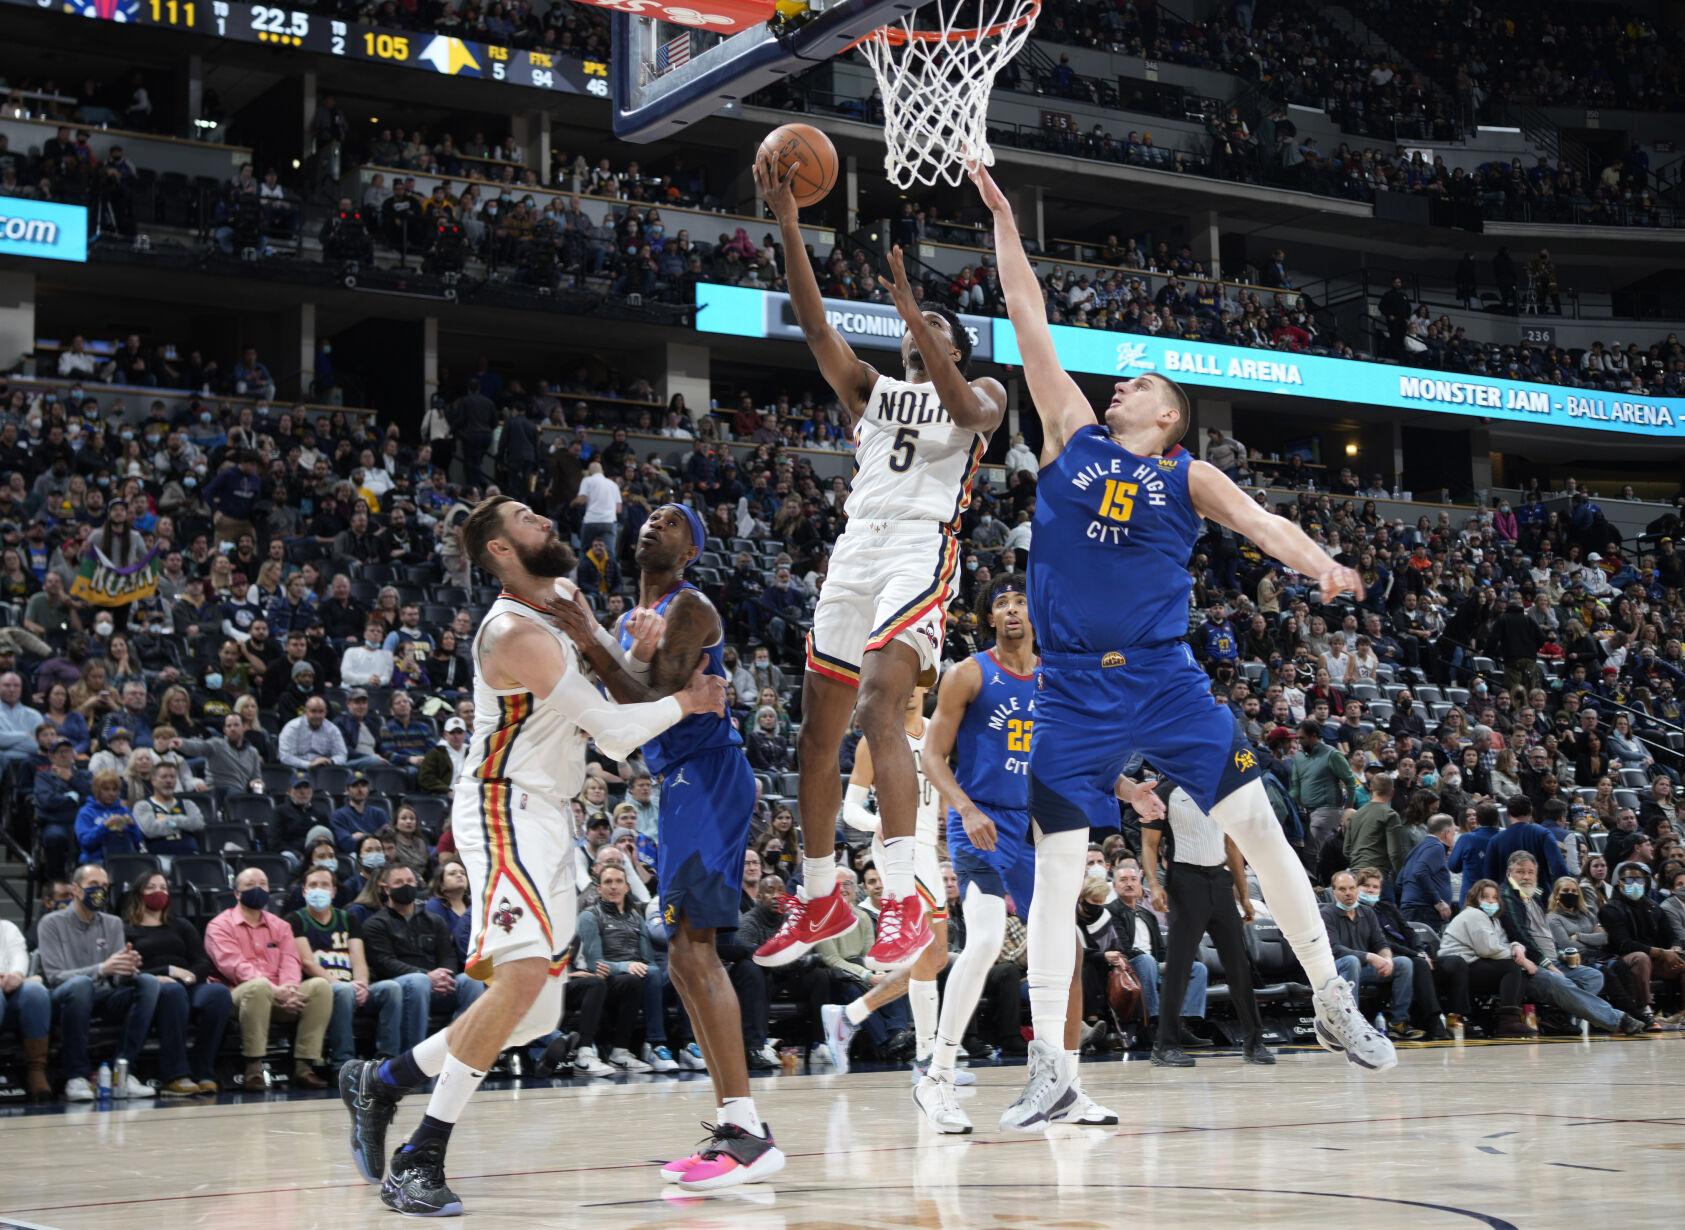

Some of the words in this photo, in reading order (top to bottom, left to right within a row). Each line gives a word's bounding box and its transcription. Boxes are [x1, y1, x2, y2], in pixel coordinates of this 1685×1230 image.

[151, 0, 195, 28] 111
[250, 6, 309, 37] 22.5
[217, 18, 226, 36] 1
[331, 37, 346, 56] 2
[363, 32, 409, 61] 105
[488, 45, 509, 60] FLS
[492, 62, 506, 80] 5
[531, 69, 554, 88] 94
[586, 79, 609, 96] 46
[1527, 330, 1550, 342] 236
[1165, 350, 1223, 376] BALL
[1228, 357, 1303, 384] ARENA
[1399, 375, 1502, 408] MONSTER
[1506, 389, 1550, 413] JAM
[1567, 395, 1609, 421] BALL
[1610, 402, 1674, 427] ARENA
[889, 427, 920, 473] 5
[1158, 459, 1178, 467] WU
[1071, 458, 1122, 491] MILE
[1132, 463, 1166, 506] HIGH
[1098, 479, 1139, 522] 15
[988, 696, 1020, 731] MILE
[1007, 718, 1034, 753] 22
[1004, 757, 1029, 776] CIT
[331, 931, 349, 950] 11
